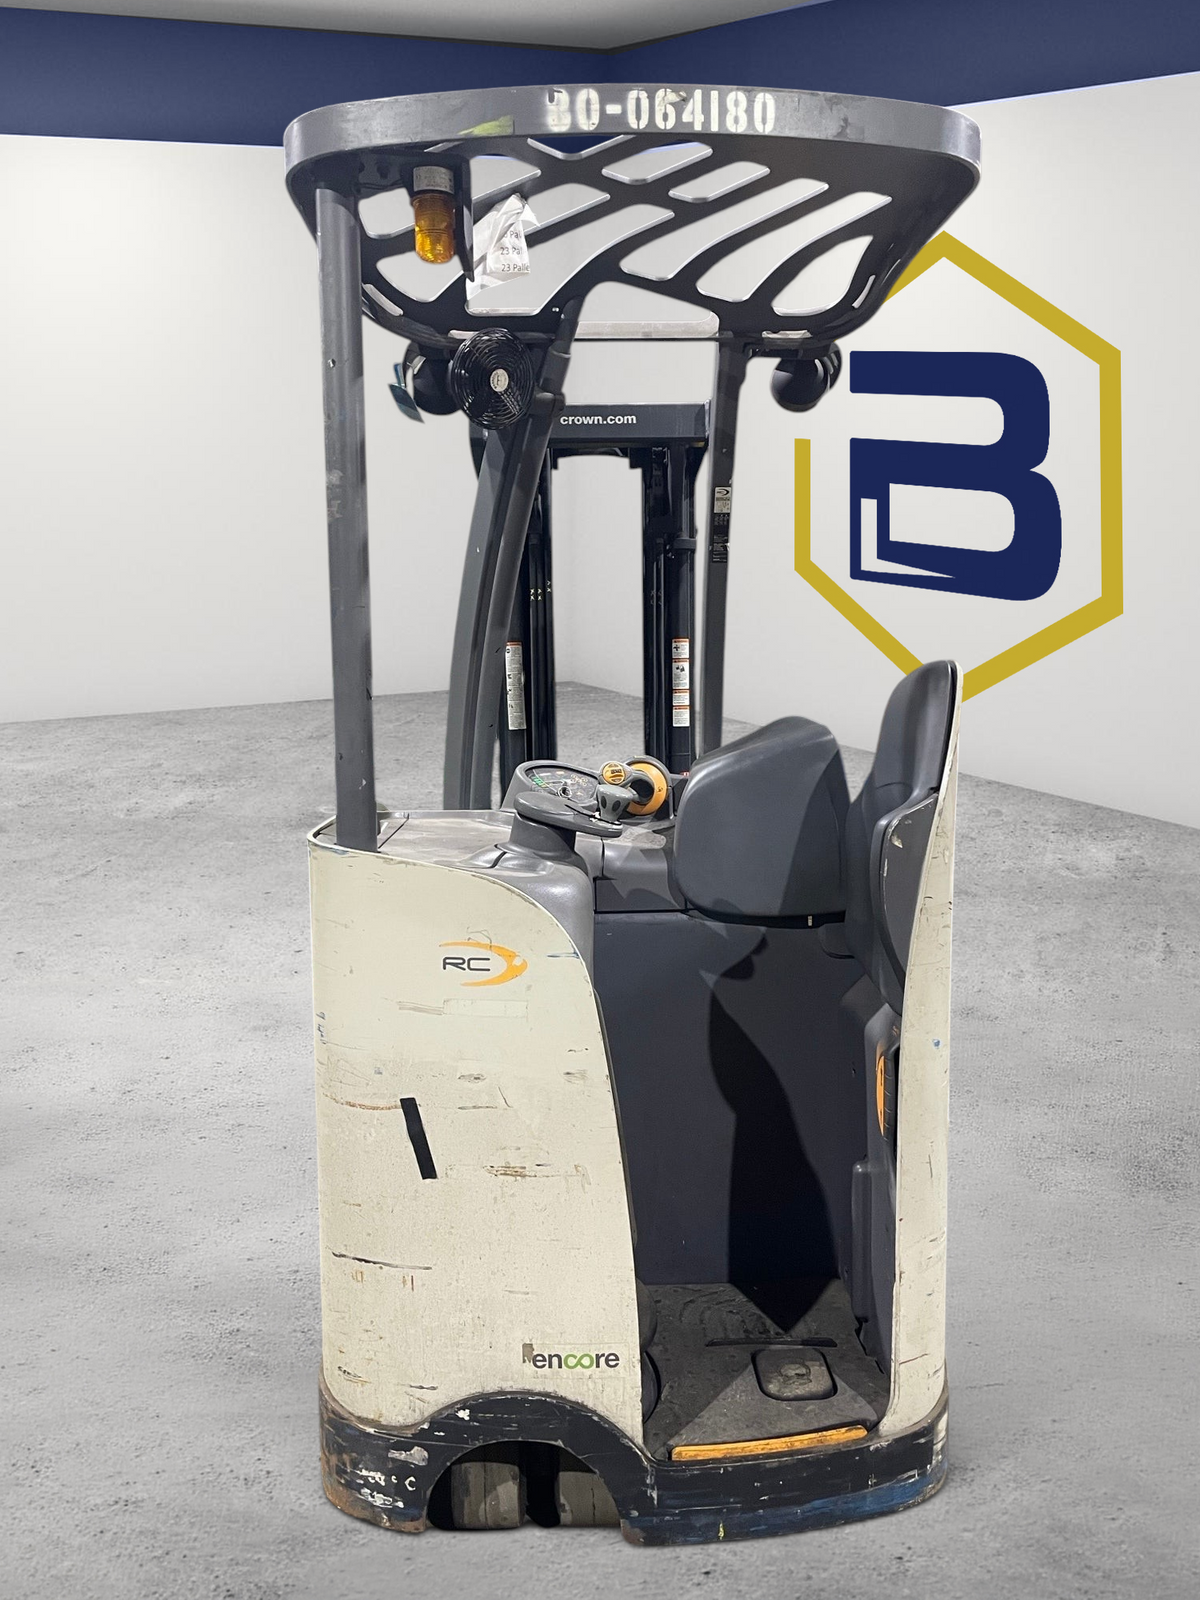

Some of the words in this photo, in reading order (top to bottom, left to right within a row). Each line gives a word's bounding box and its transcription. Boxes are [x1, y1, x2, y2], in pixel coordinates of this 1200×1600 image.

[500, 246, 510, 256] 23
[501, 263, 511, 272] 23
[560, 415, 637, 425] crown.com
[850, 350, 1062, 601] B
[443, 956, 491, 972] RC
[532, 1352, 620, 1370] encore
